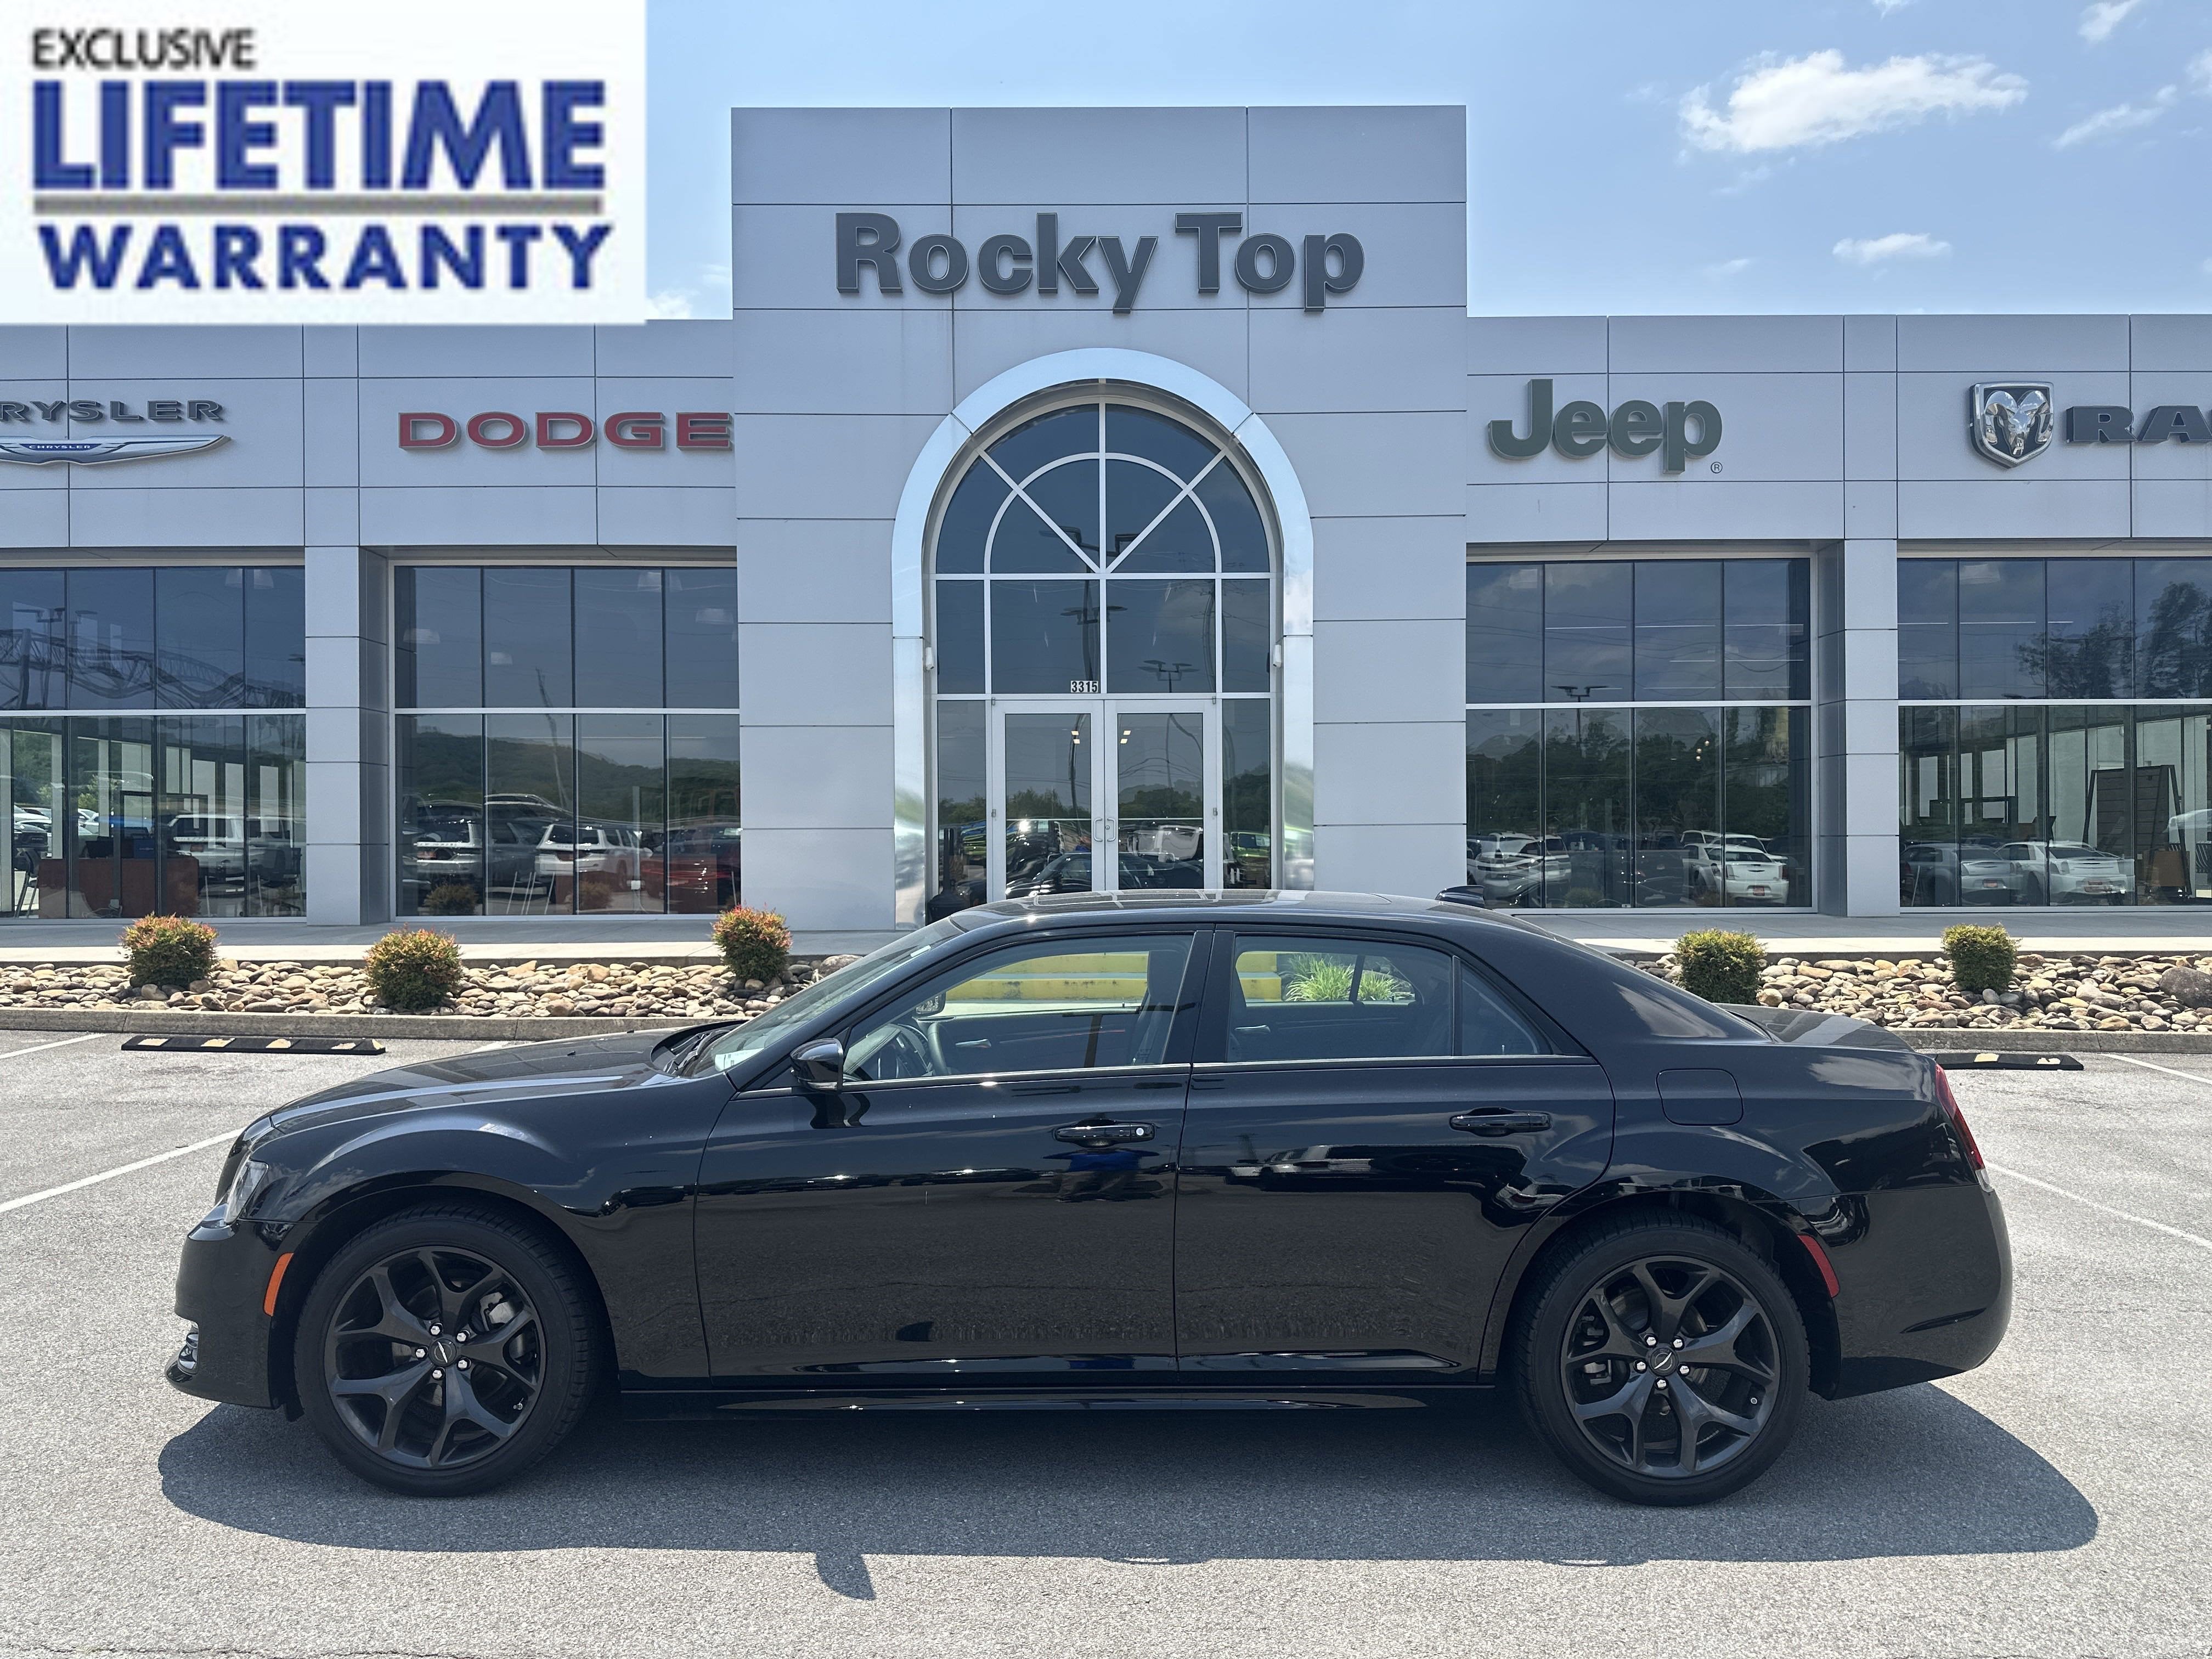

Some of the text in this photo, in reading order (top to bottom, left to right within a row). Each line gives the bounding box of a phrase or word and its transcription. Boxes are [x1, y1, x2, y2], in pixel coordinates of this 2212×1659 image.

[835, 212, 1365, 314] Rocky Top
[398, 411, 734, 452] DODGE
[1487, 378, 1723, 474] Jeep
[2066, 405, 2212, 443] RA
[1071, 681, 1098, 692] 3315
